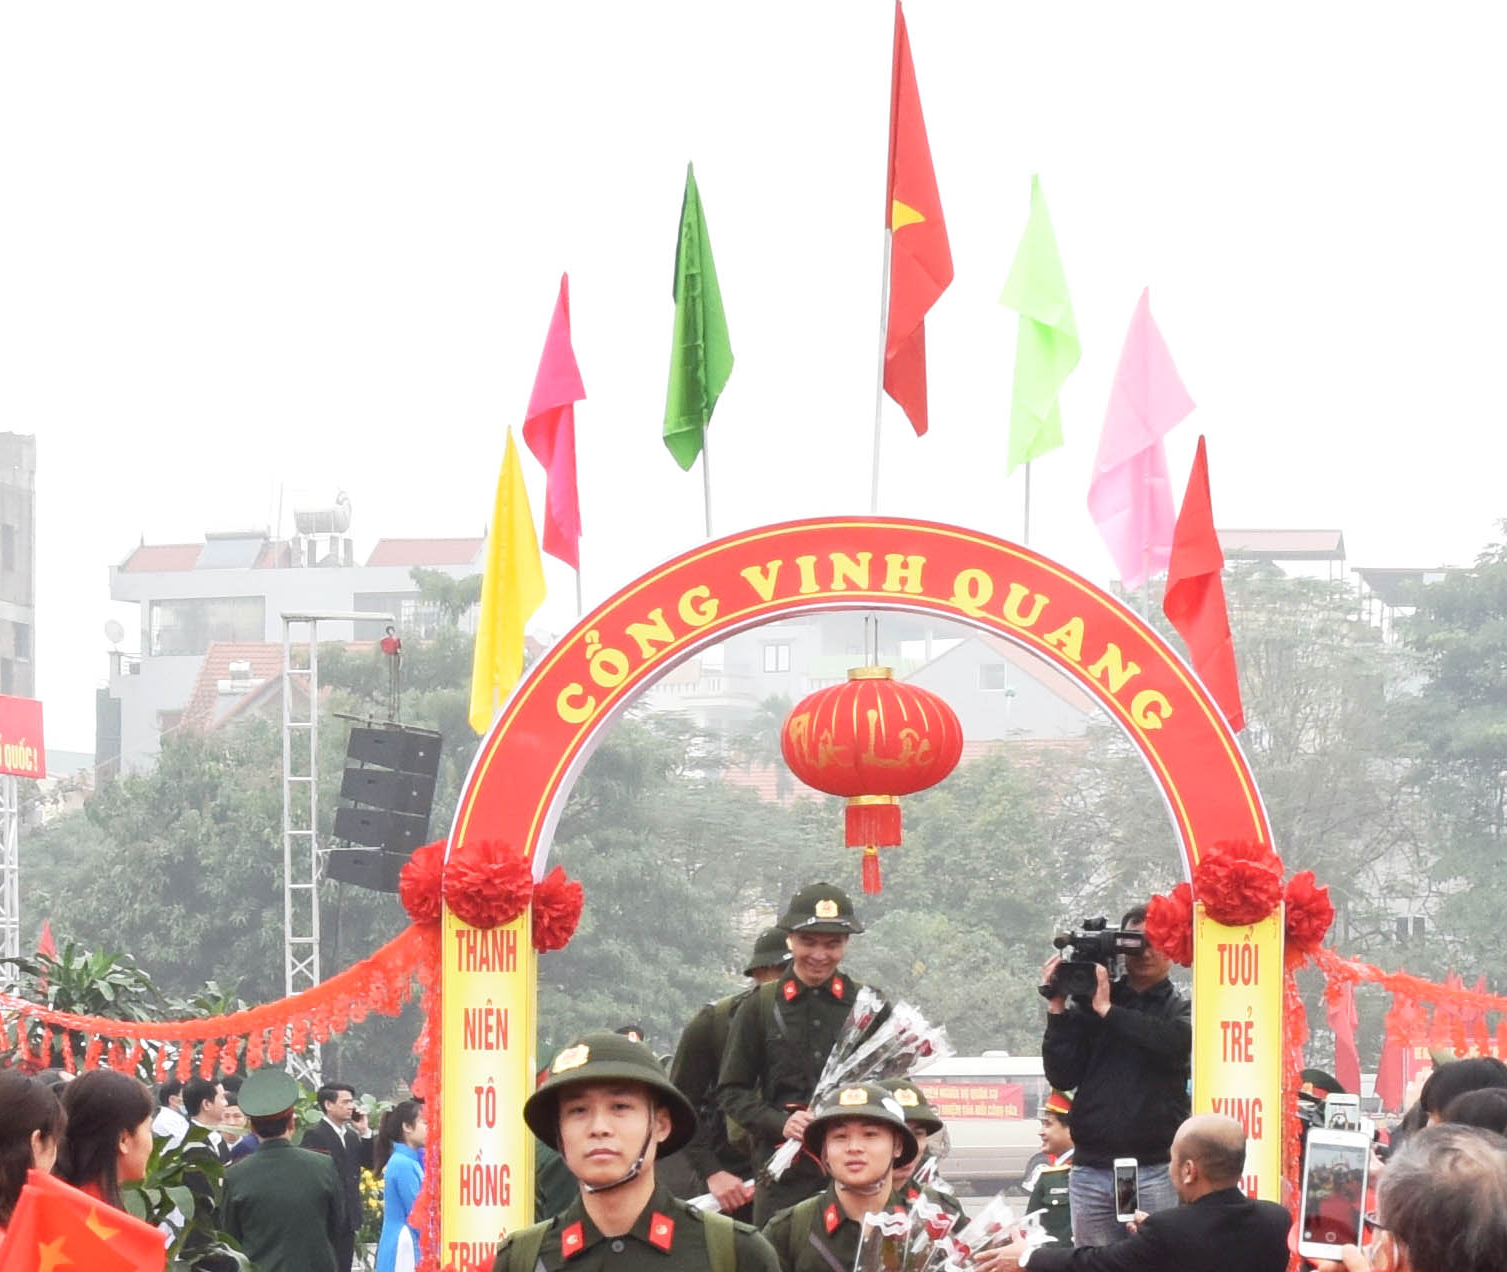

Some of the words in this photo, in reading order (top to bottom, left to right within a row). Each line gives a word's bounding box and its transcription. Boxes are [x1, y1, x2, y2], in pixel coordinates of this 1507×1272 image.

[556, 585, 722, 725] CỔNG
[740, 550, 926, 602] VINH
[951, 568, 1174, 731] QUANG
[455, 929, 517, 973] THANH
[1217, 924, 1259, 987] TUỔI
[463, 998, 509, 1051] NIÊN
[1220, 1005, 1254, 1064] TRẺ
[474, 1076, 497, 1129] TÔ
[459, 1149, 511, 1207] HỒNG
